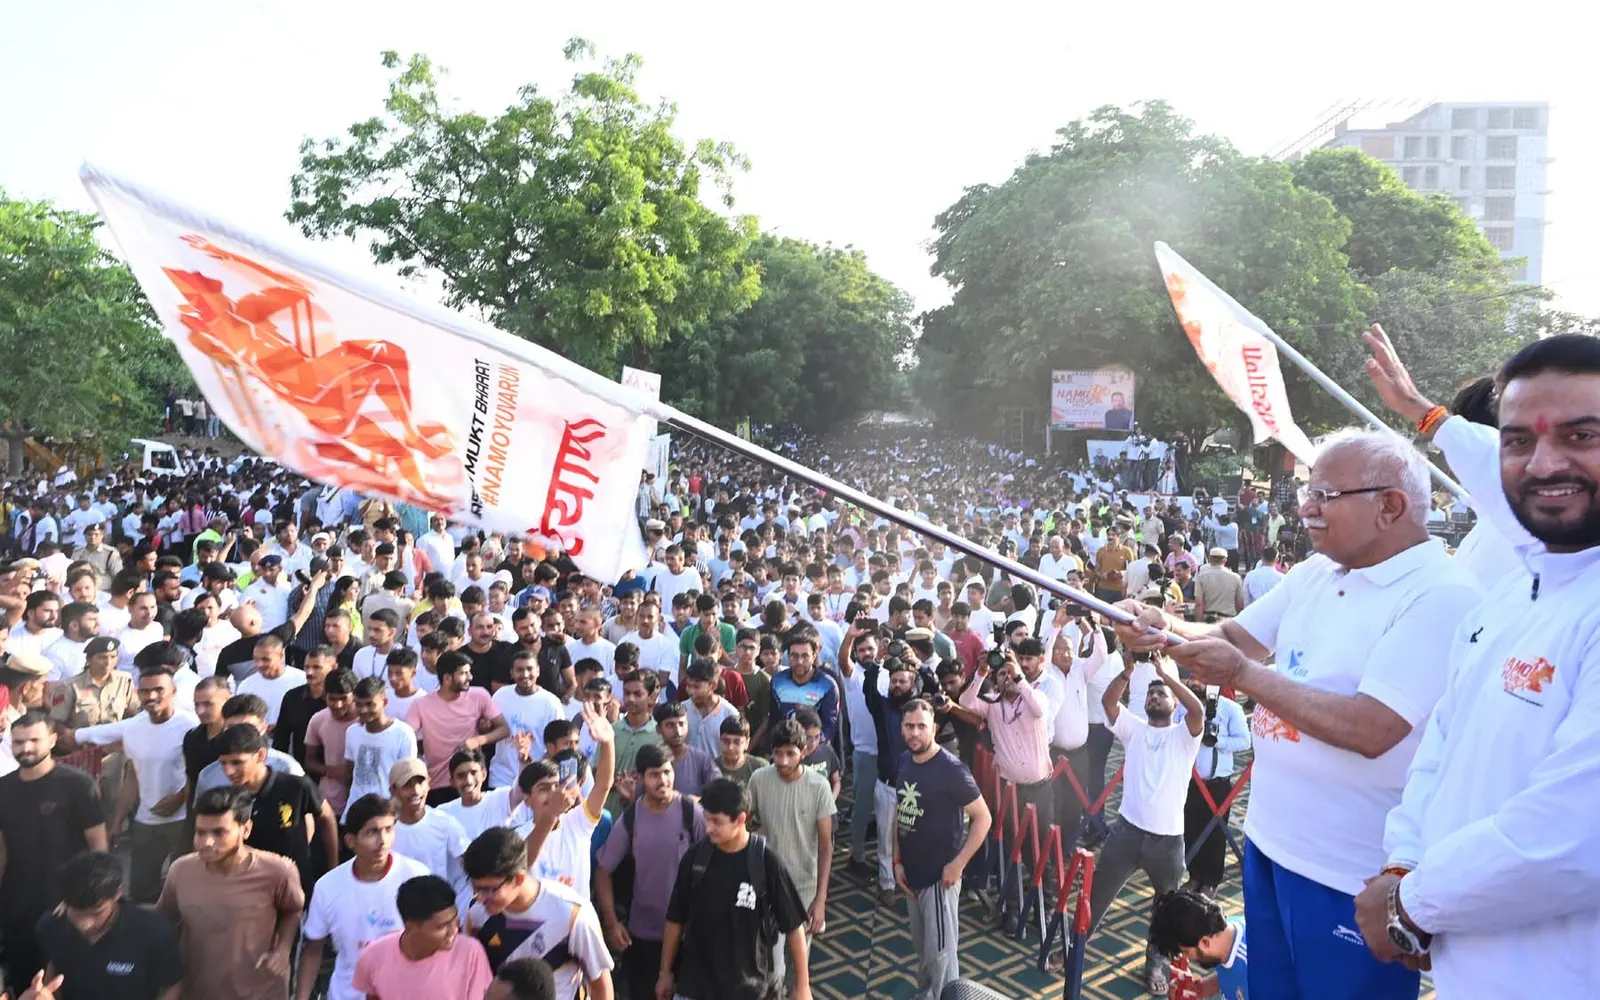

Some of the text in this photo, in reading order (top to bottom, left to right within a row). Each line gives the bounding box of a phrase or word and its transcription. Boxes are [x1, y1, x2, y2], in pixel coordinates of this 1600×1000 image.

[464, 413, 485, 475] MUKT
[475, 358, 490, 414] BHARAT
[480, 363, 520, 507] #NAMOYUVARUN
